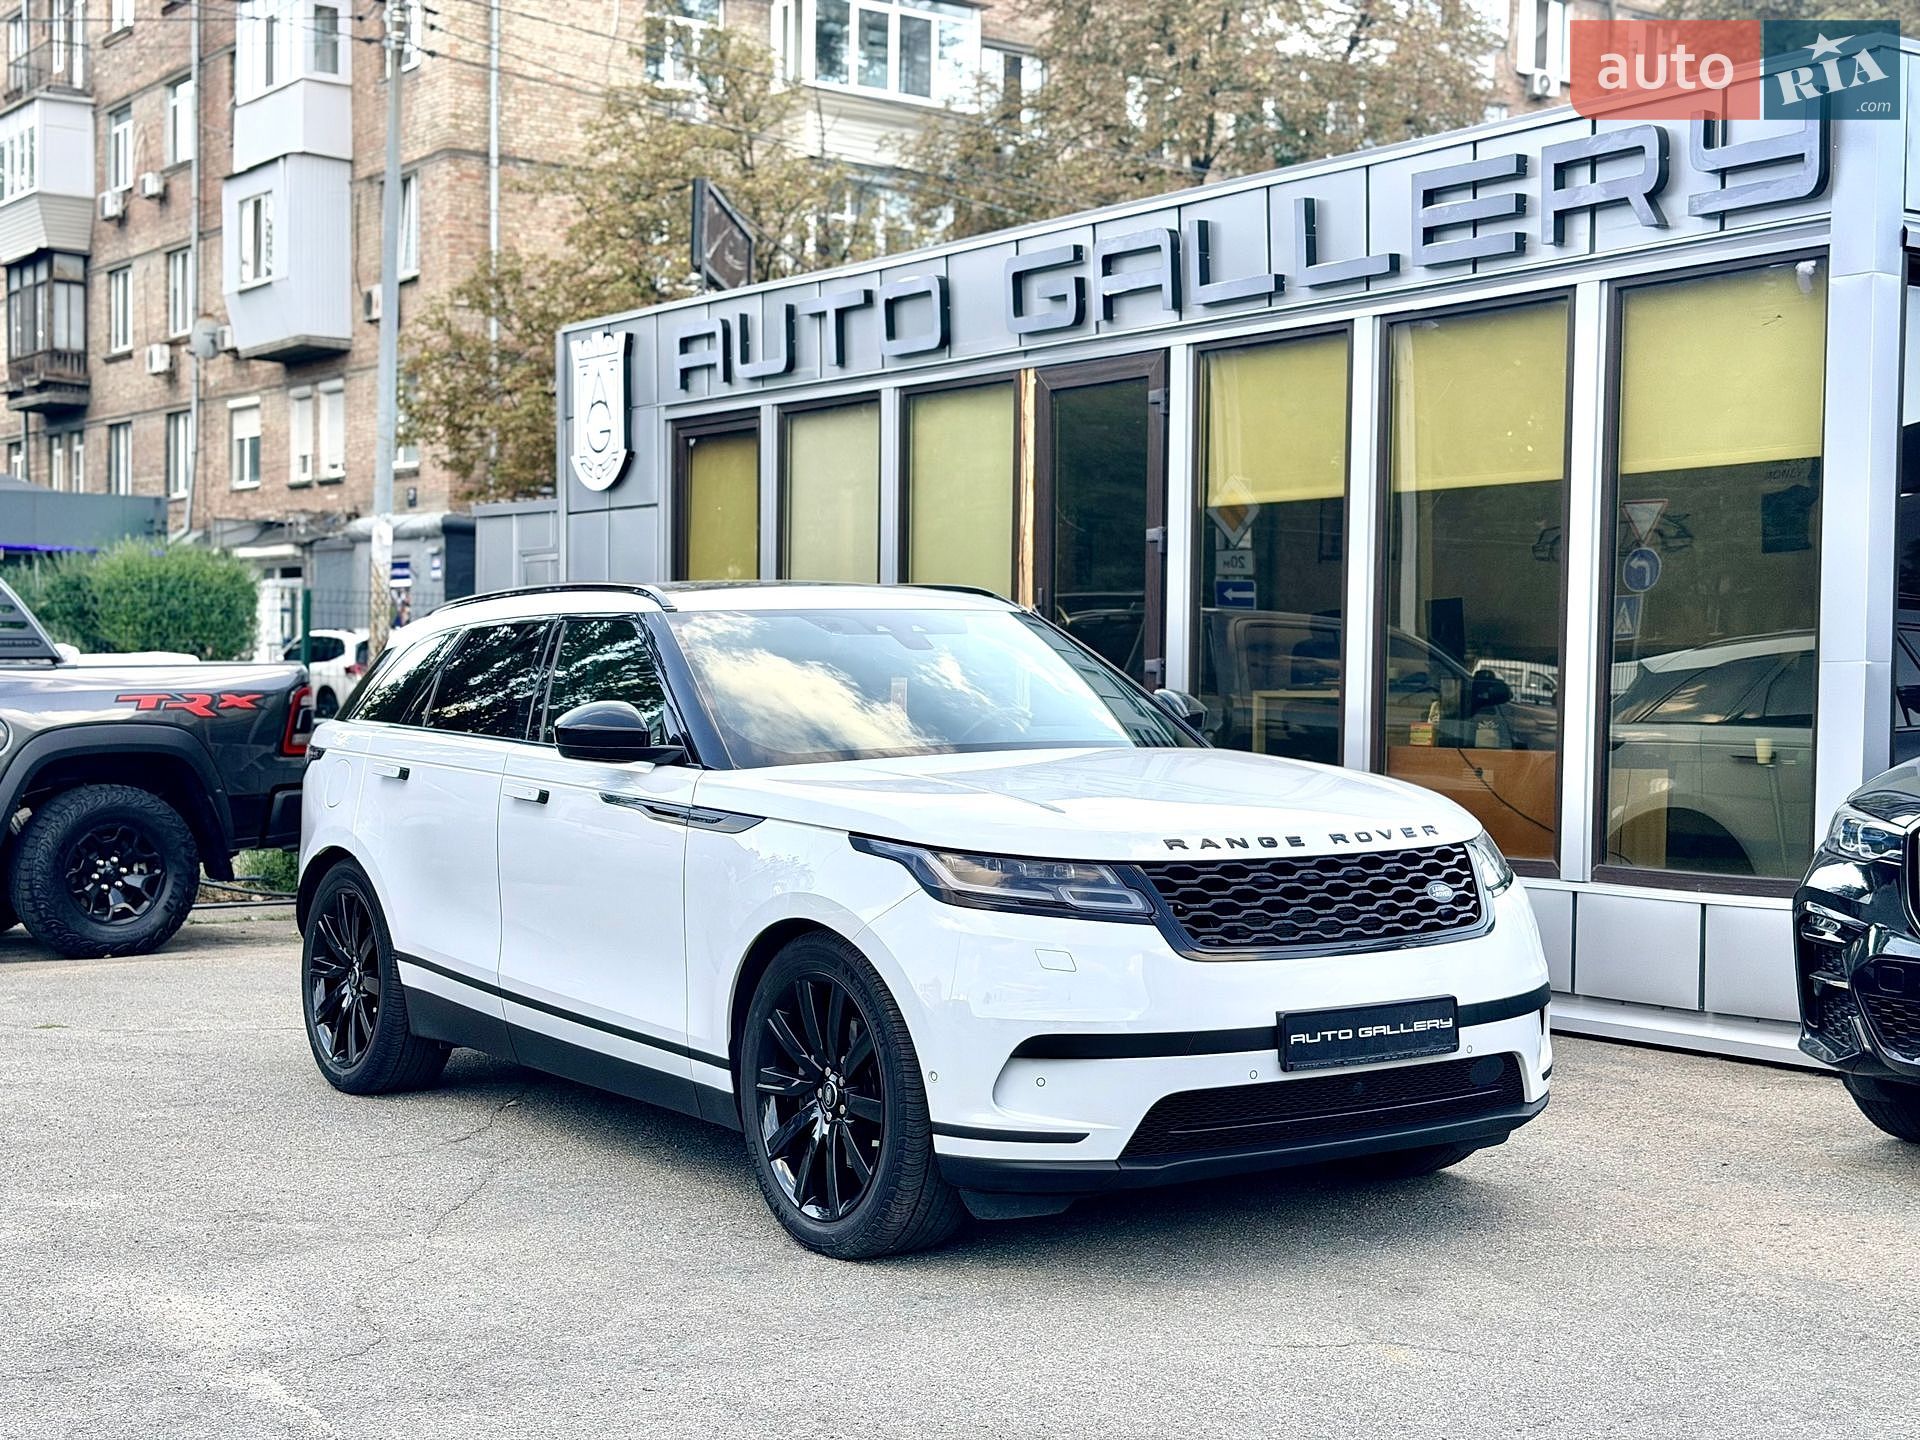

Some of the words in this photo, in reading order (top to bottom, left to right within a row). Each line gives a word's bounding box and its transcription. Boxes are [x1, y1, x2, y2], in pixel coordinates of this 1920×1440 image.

[675, 274, 950, 392] AUTO
[1005, 84, 1832, 336] GALLERY
[114, 692, 267, 719] TRX
[1162, 835, 1306, 851] RANGE
[1328, 824, 1440, 845] ROVER
[1290, 1029, 1353, 1046] AUTO
[1358, 1017, 1454, 1039] GALLERY
